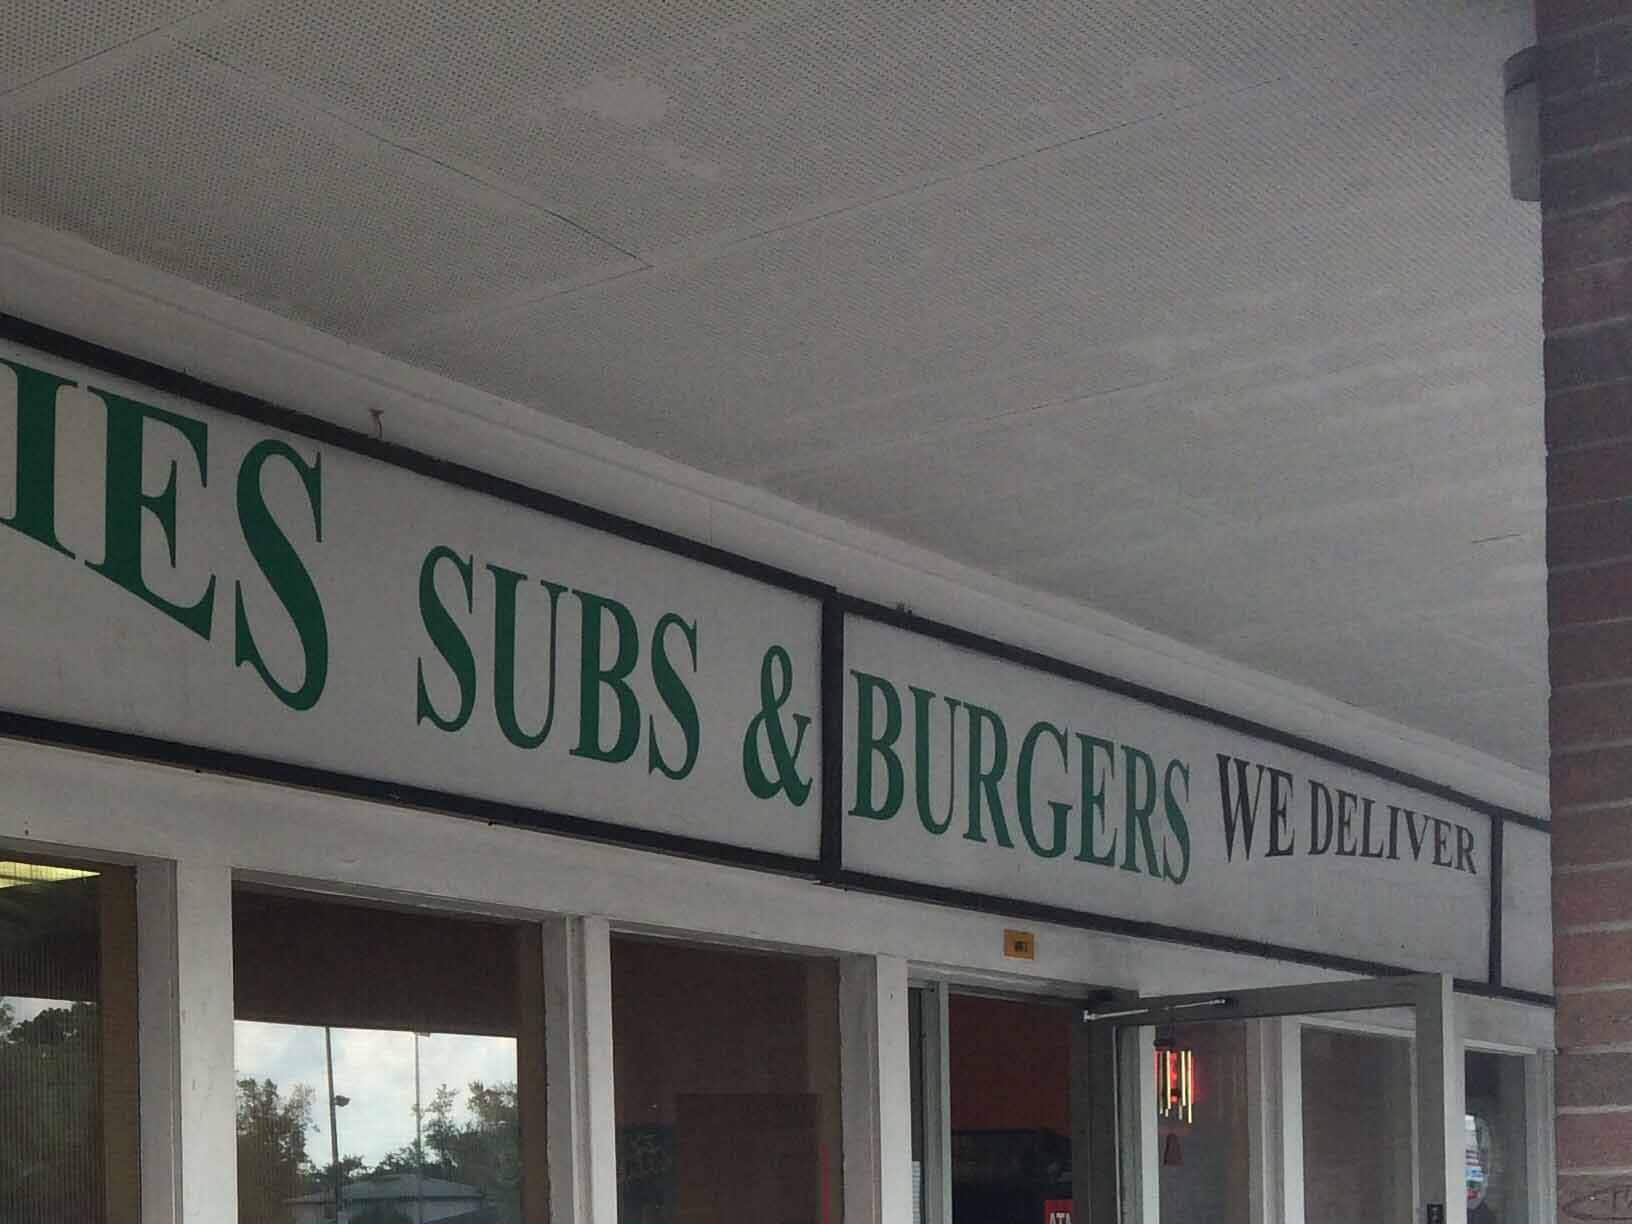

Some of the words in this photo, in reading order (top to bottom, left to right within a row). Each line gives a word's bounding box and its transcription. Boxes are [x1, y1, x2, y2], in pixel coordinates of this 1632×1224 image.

[417, 545, 700, 780] SUBS
[742, 645, 814, 806] &
[848, 670, 1192, 885] BURGERS
[1216, 753, 1295, 862] WE
[1308, 779, 1477, 875] DELIVER
